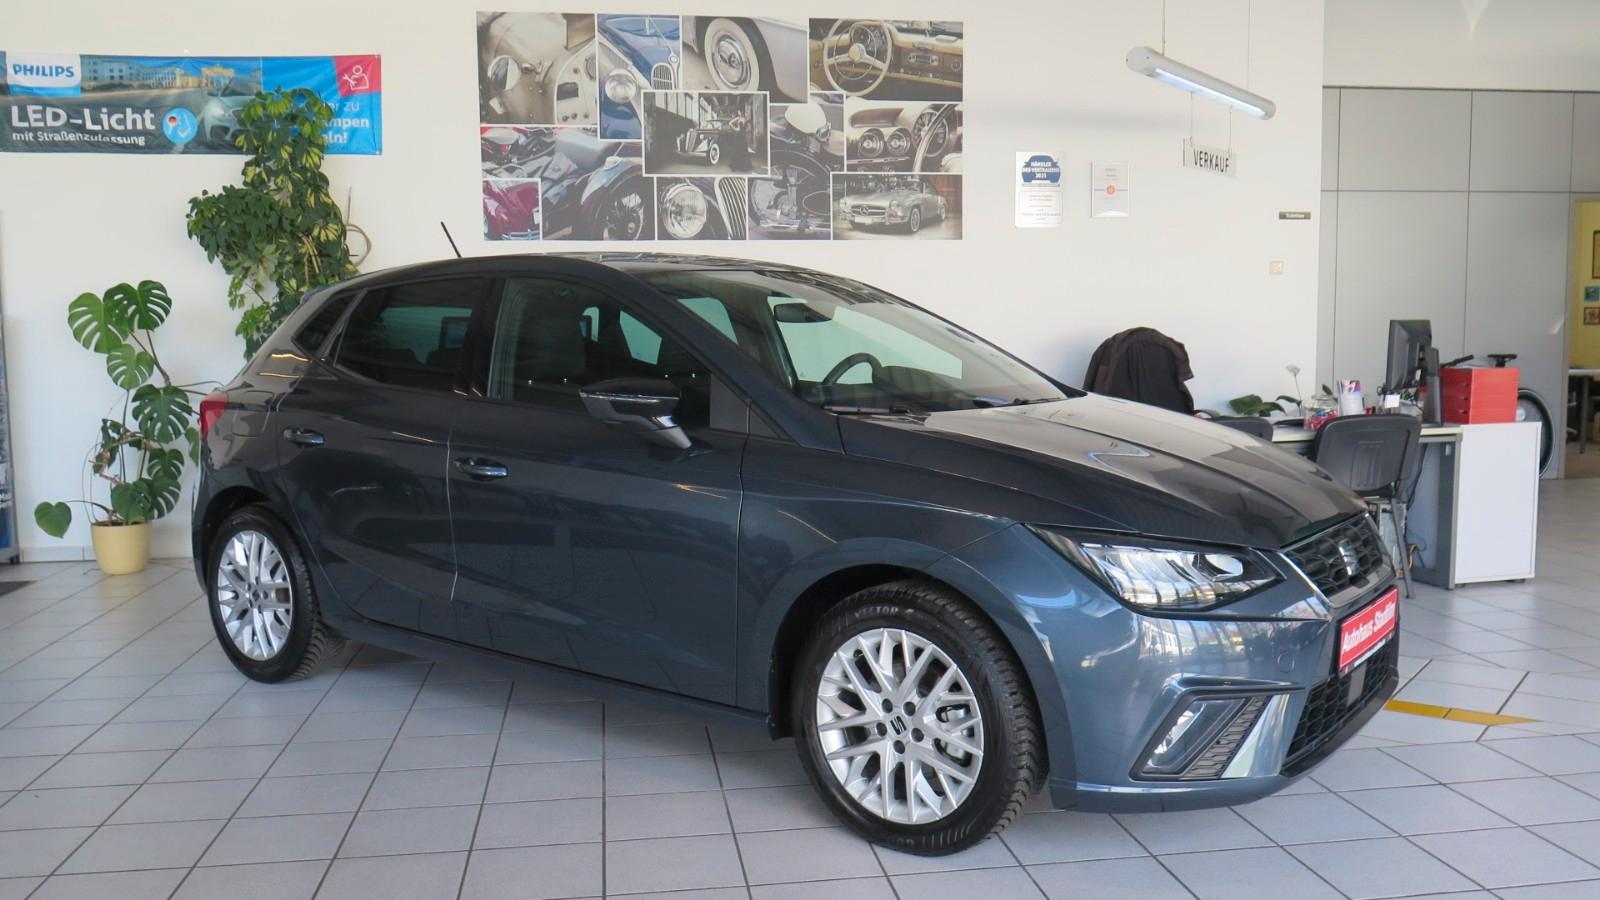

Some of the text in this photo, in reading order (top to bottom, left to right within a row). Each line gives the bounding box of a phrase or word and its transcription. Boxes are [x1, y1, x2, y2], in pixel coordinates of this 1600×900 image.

[12, 63, 74, 78] PHILIPS
[344, 102, 360, 112] zu
[11, 104, 156, 131] LED-Licht
[12, 131, 146, 146] mit Straßenzulassung
[1193, 148, 1230, 174] VERKAUF
